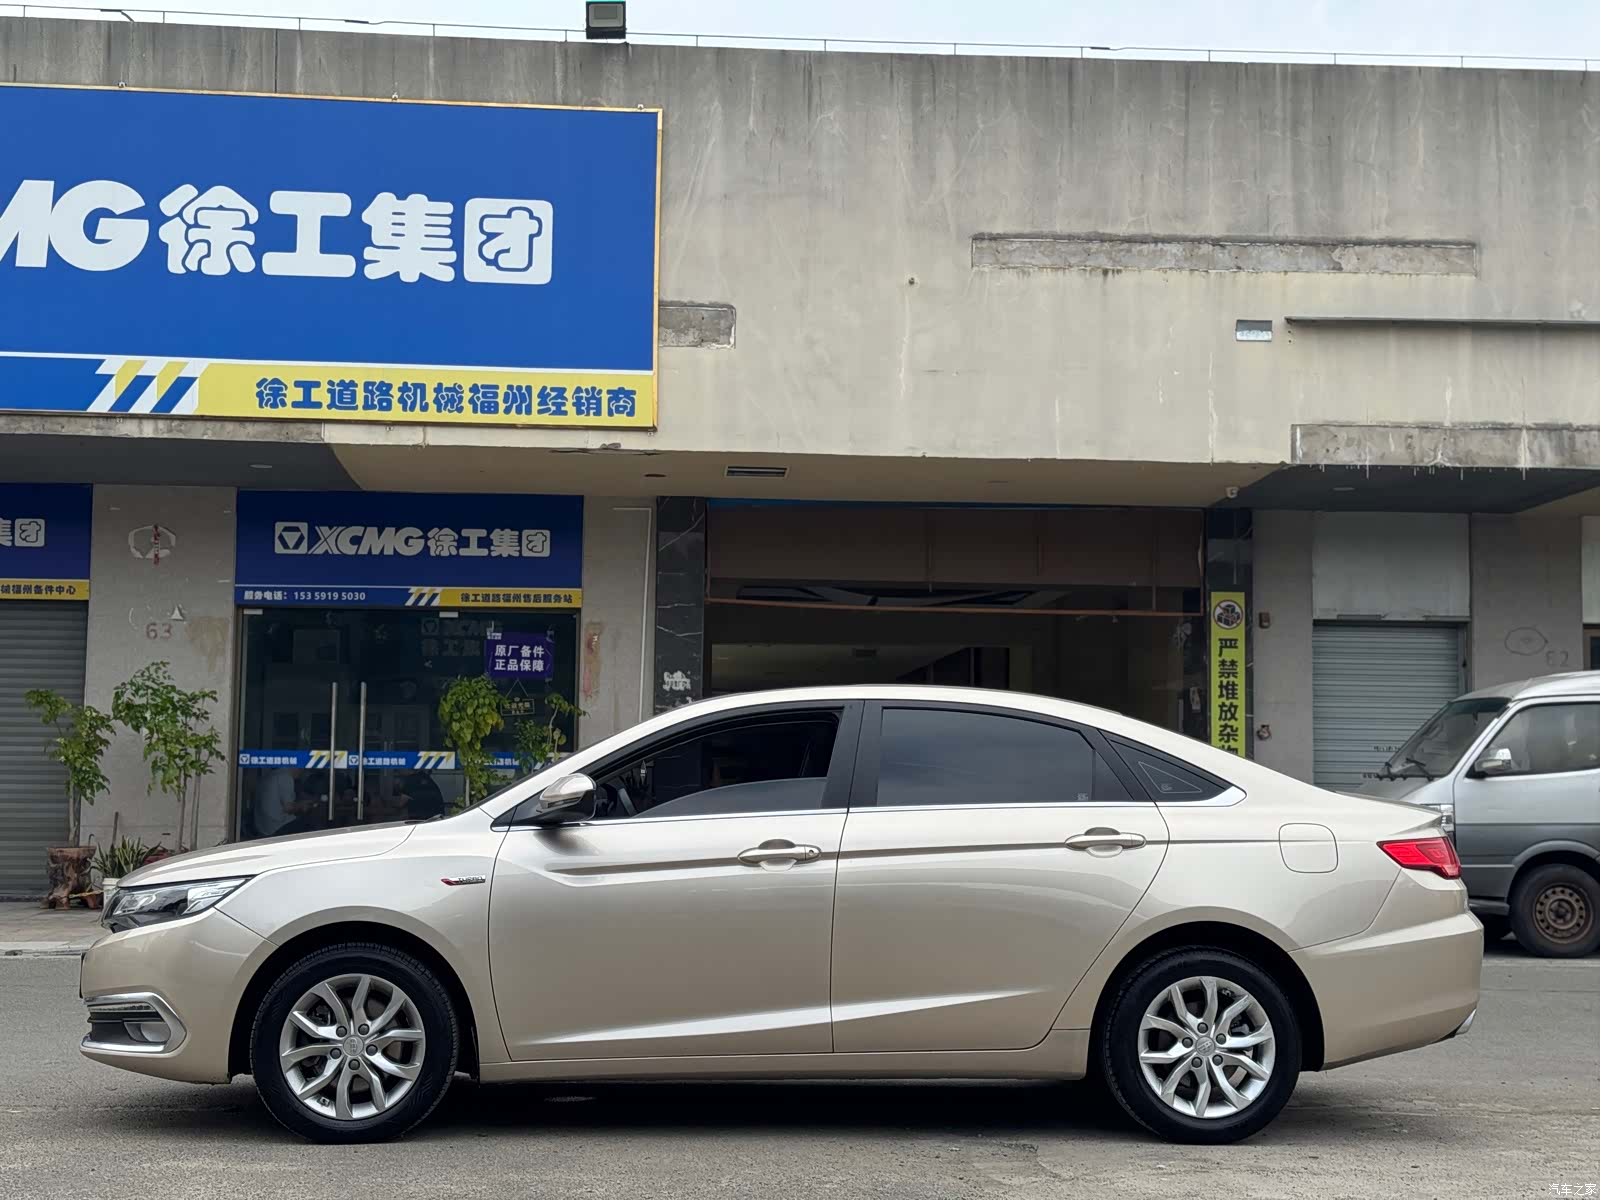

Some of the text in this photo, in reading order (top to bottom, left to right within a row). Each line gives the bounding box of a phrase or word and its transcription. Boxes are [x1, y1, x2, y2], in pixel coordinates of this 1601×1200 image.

[255, 377, 637, 417] 徐工道路机械福州经销商
[294, 592, 312, 600] 153
[314, 592, 339, 601] 5919
[341, 592, 366, 601] 5030
[145, 622, 173, 640] 63
[495, 645, 545, 658] 原厂备件
[494, 659, 545, 672] 正品保障
